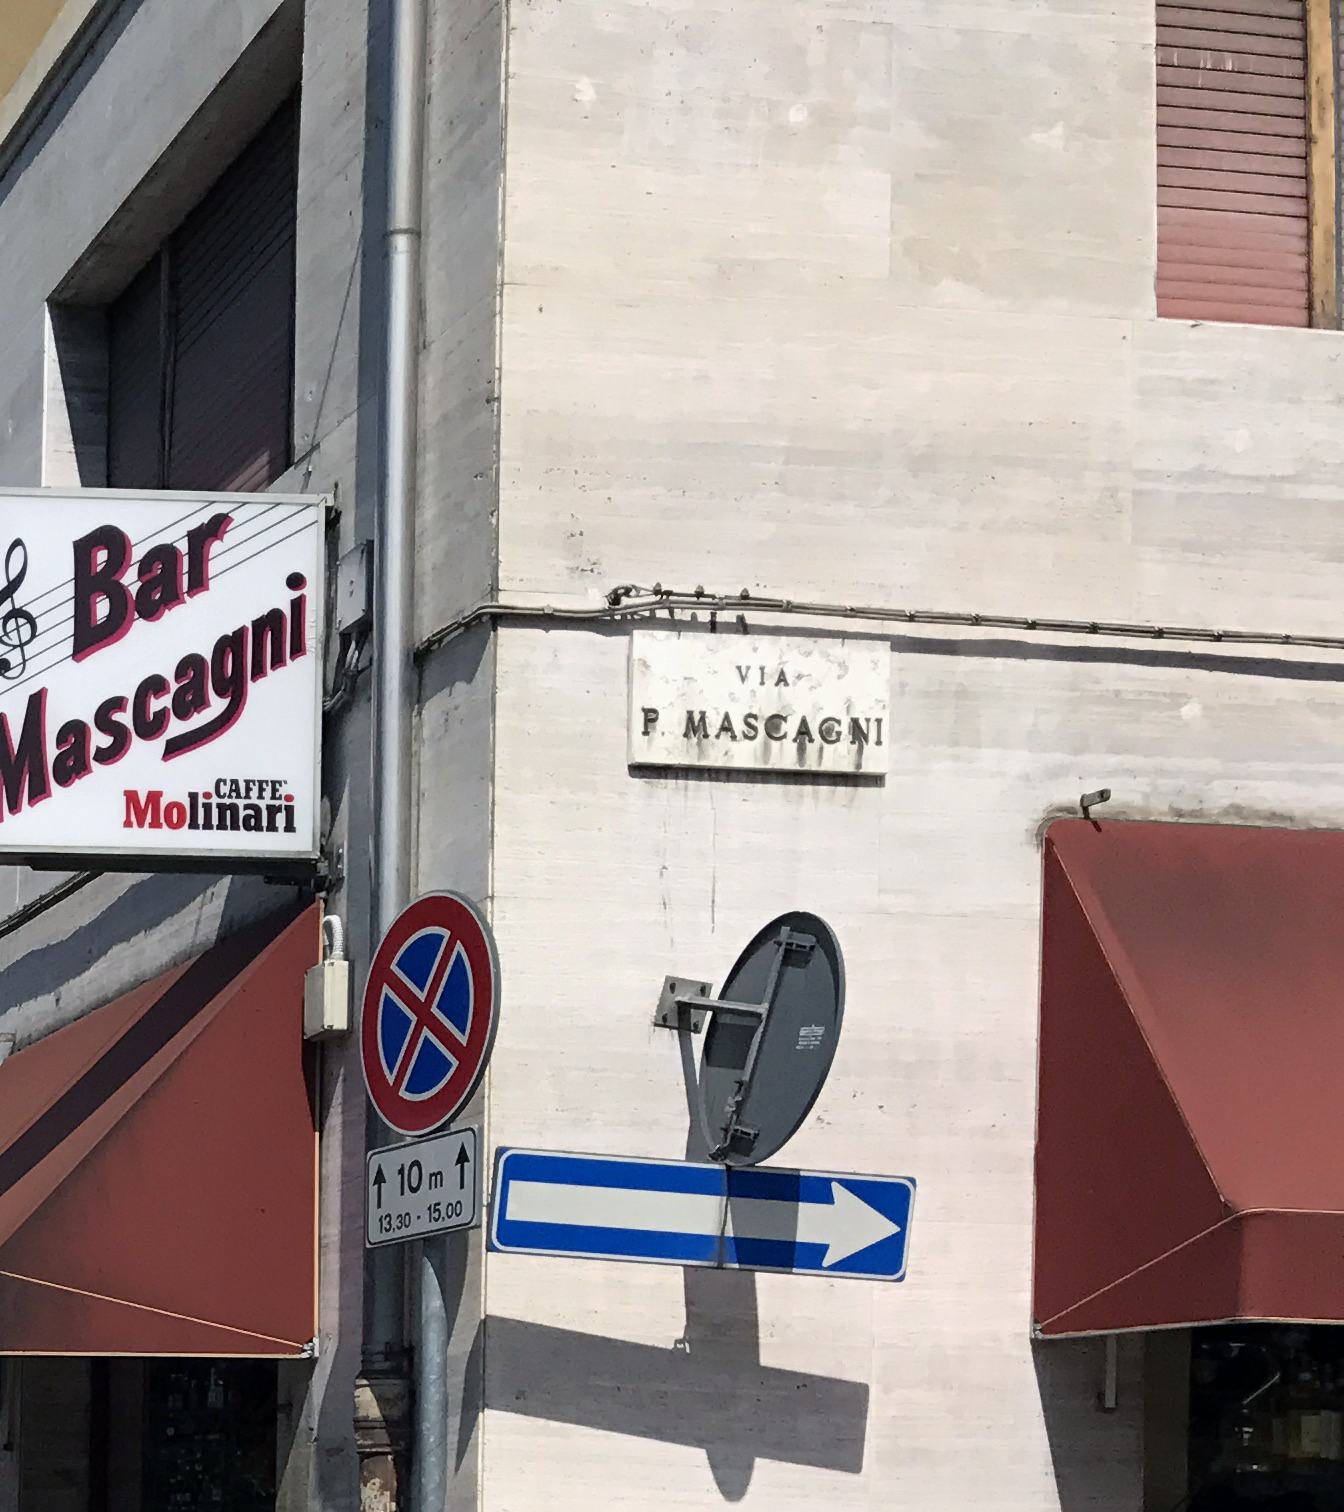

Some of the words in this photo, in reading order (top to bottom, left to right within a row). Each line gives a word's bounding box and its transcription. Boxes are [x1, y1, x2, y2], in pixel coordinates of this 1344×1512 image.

[72, 512, 235, 664] Bar
[735, 665, 790, 687] VIA
[641, 706, 666, 737] P.
[682, 709, 884, 747] MASCAGNI
[123, 789, 297, 834] Molinari
[397, 1159, 423, 1197] 10
[428, 1170, 444, 1191] m
